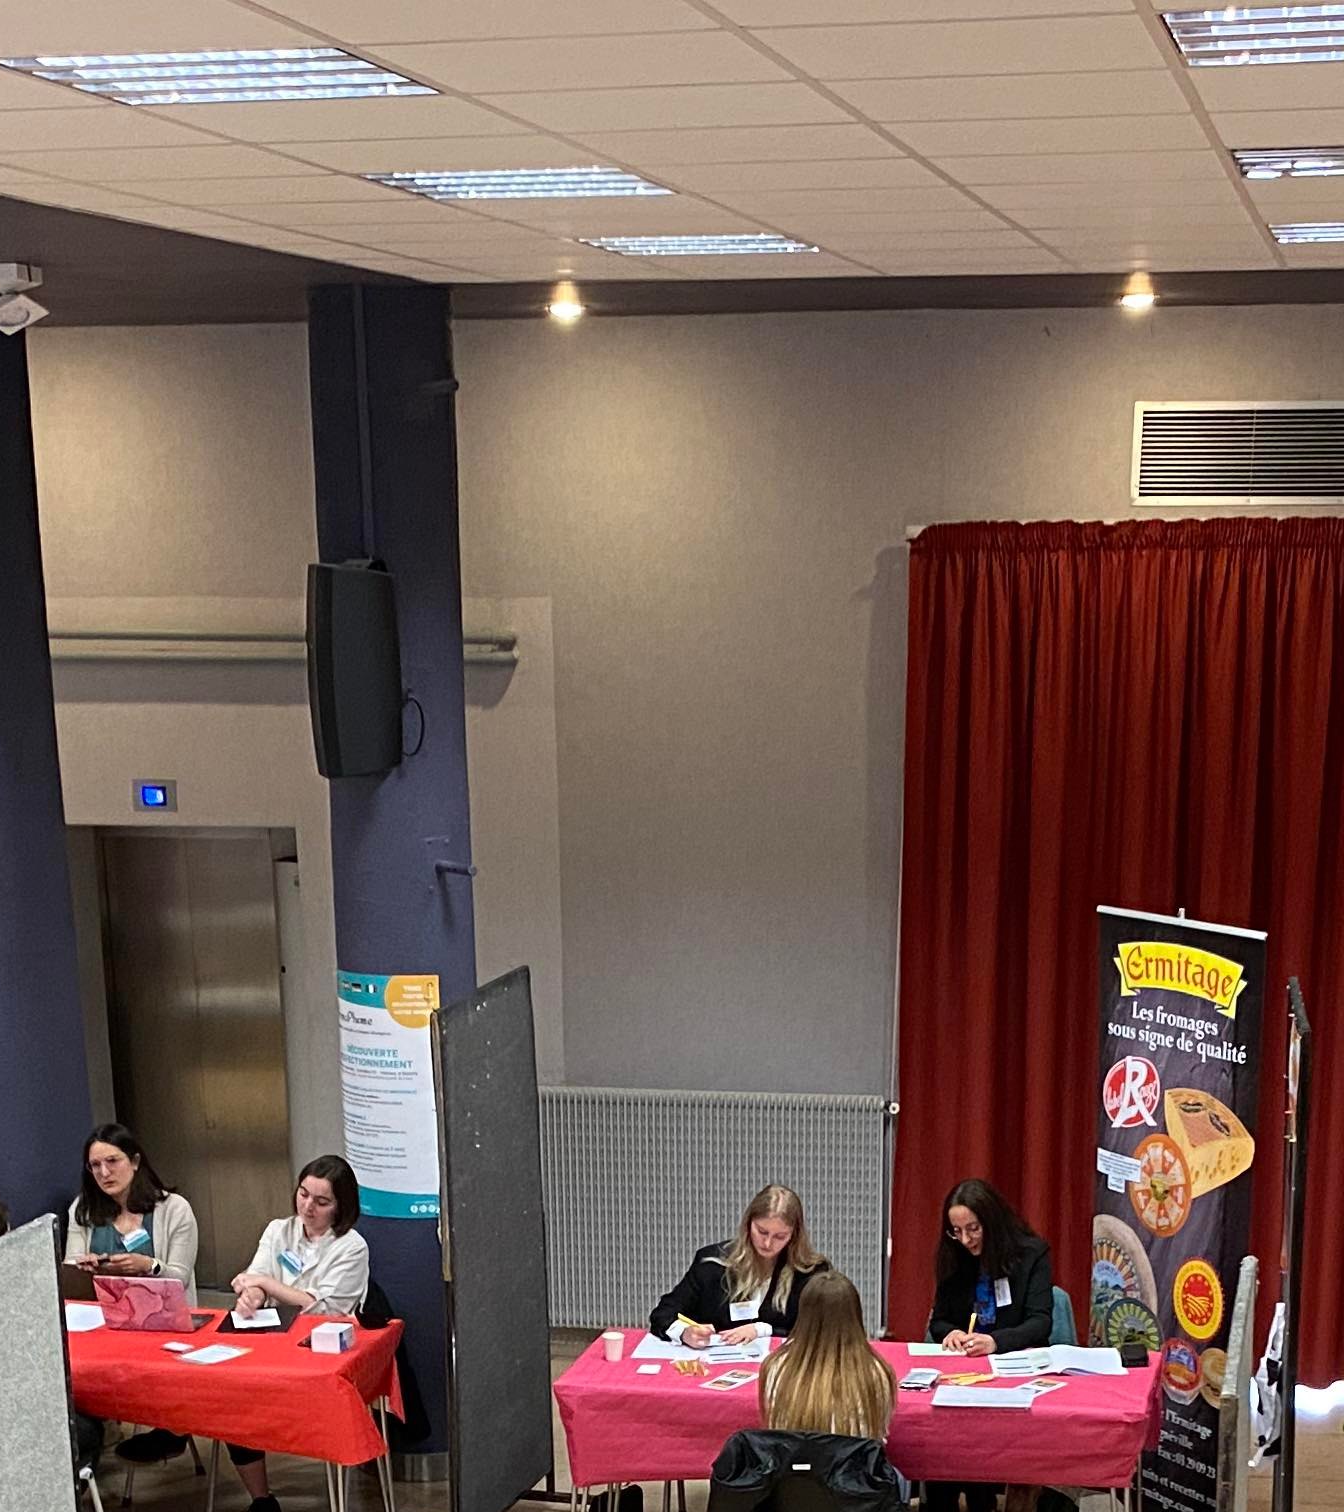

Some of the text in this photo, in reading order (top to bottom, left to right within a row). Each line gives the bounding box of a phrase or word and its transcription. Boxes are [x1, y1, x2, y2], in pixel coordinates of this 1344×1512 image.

[1126, 945, 1233, 999] Ermitage
[1132, 1001, 1219, 1039] Les fromages
[1107, 1022, 1247, 1064] sous signe de qualité
